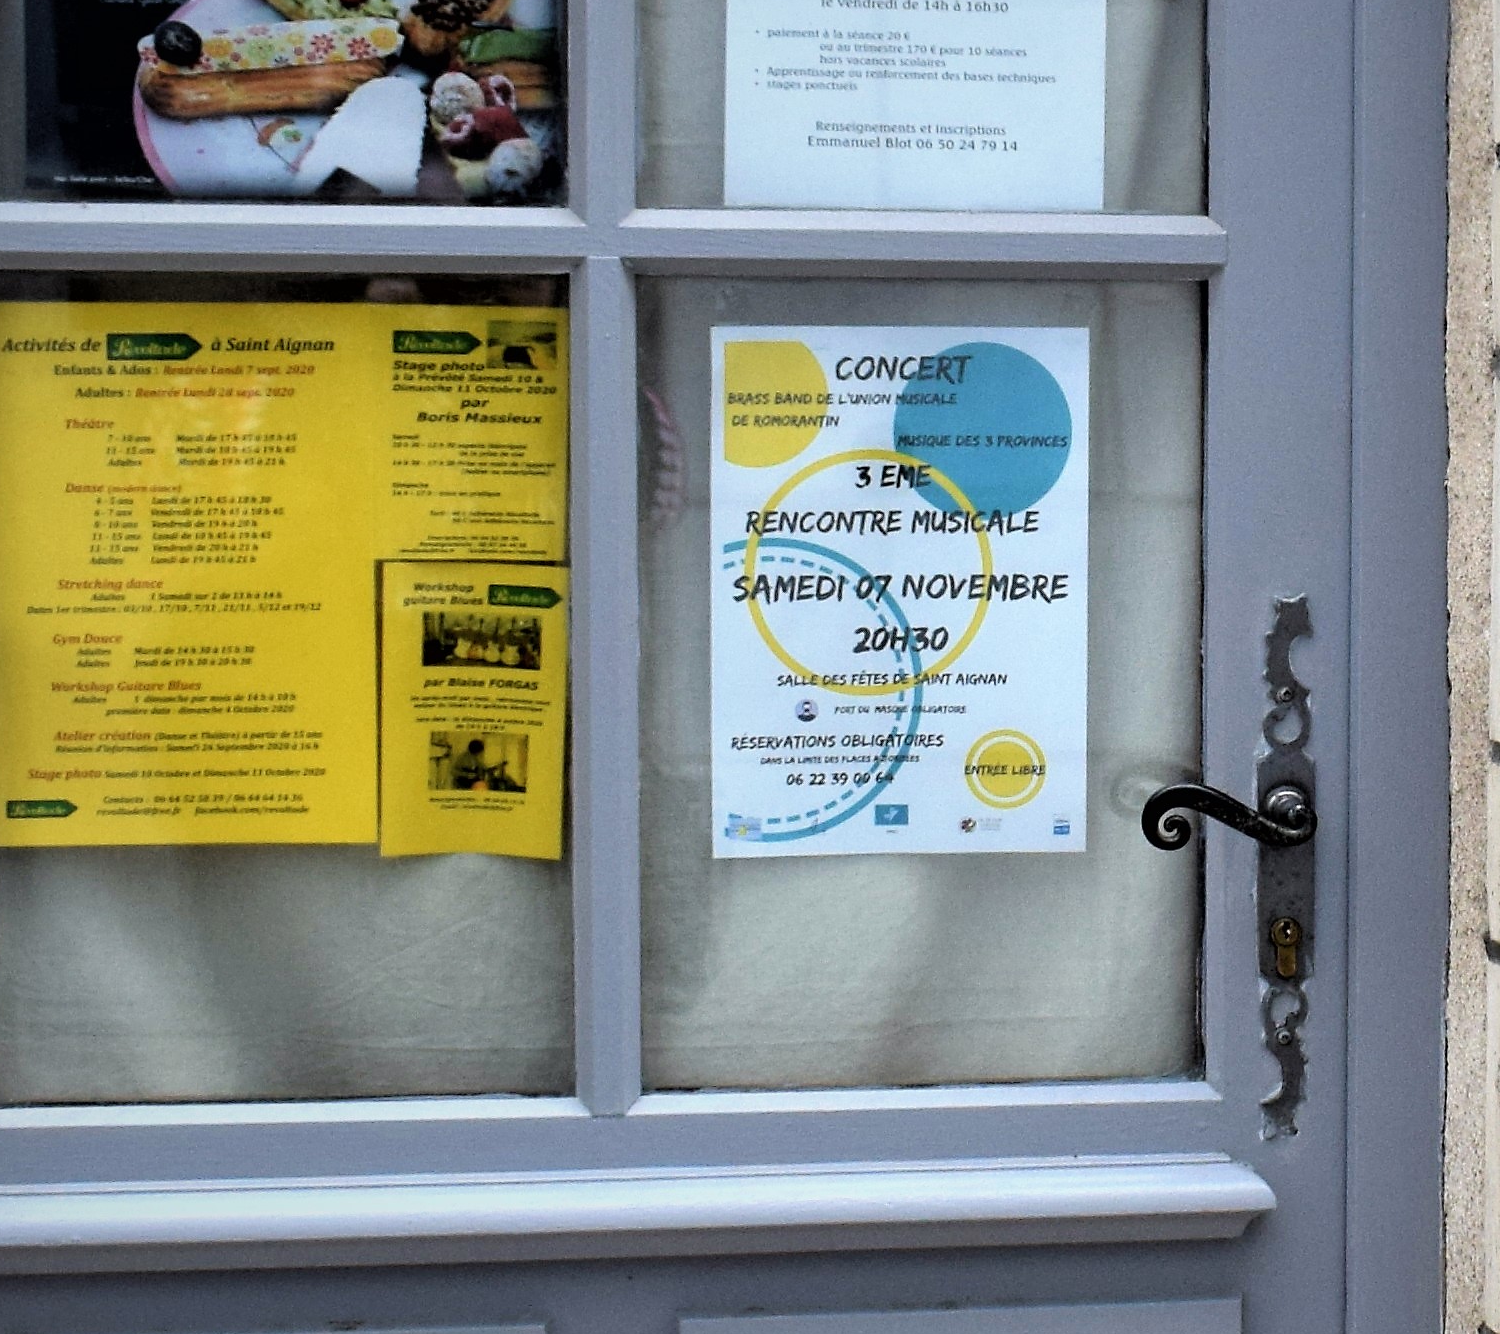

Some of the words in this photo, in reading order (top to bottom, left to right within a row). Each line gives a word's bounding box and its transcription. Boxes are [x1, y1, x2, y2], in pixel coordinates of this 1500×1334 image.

[925, 0, 948, 12] 14h
[953, 0, 961, 12] à
[967, 1, 1008, 13] 16h30
[808, 135, 880, 148] Emmanuel
[886, 137, 911, 149] Blot
[916, 138, 932, 149] 06
[939, 139, 954, 150] 50
[959, 139, 975, 150] 24
[982, 140, 996, 151] 79
[1003, 140, 1017, 152] 14
[211, 336, 221, 351] à
[225, 337, 270, 351] Saint
[274, 337, 334, 356] Aignan
[836, 356, 971, 385] CONCERT
[460, 399, 489, 409] par
[728, 393, 769, 406] BRASS
[775, 392, 812, 405] BAND
[817, 393, 833, 405] DE
[839, 392, 891, 405] L'UNION
[896, 393, 956, 405] MUSICALE
[732, 415, 748, 427] DE
[754, 414, 840, 428] ROMORANTIN
[898, 434, 951, 448] MUSIQUE
[956, 435, 980, 447] DES
[985, 436, 993, 447] 3
[997, 434, 1068, 448] PROVINCES
[855, 465, 871, 488] 3
[746, 510, 902, 535] RENCONTRE
[912, 509, 1039, 535] MUSICALE
[733, 574, 843, 604] SAMEDI
[855, 575, 892, 602] 07
[902, 574, 1068, 605] NOVEMBRE
[853, 627, 948, 654] 20H30
[778, 672, 818, 687] SALLE
[822, 674, 846, 687] DES
[851, 671, 888, 686] FÊTES
[893, 673, 909, 685] DE
[914, 673, 952, 686] SAINT
[956, 673, 1007, 687] AIGNAN
[732, 733, 836, 750] RÉSERVATIONS
[841, 734, 944, 748] OBLIGATOIRES
[787, 773, 803, 785] 06
[809, 772, 825, 786] 22
[831, 772, 848, 786] 39
[853, 773, 871, 786] 00
